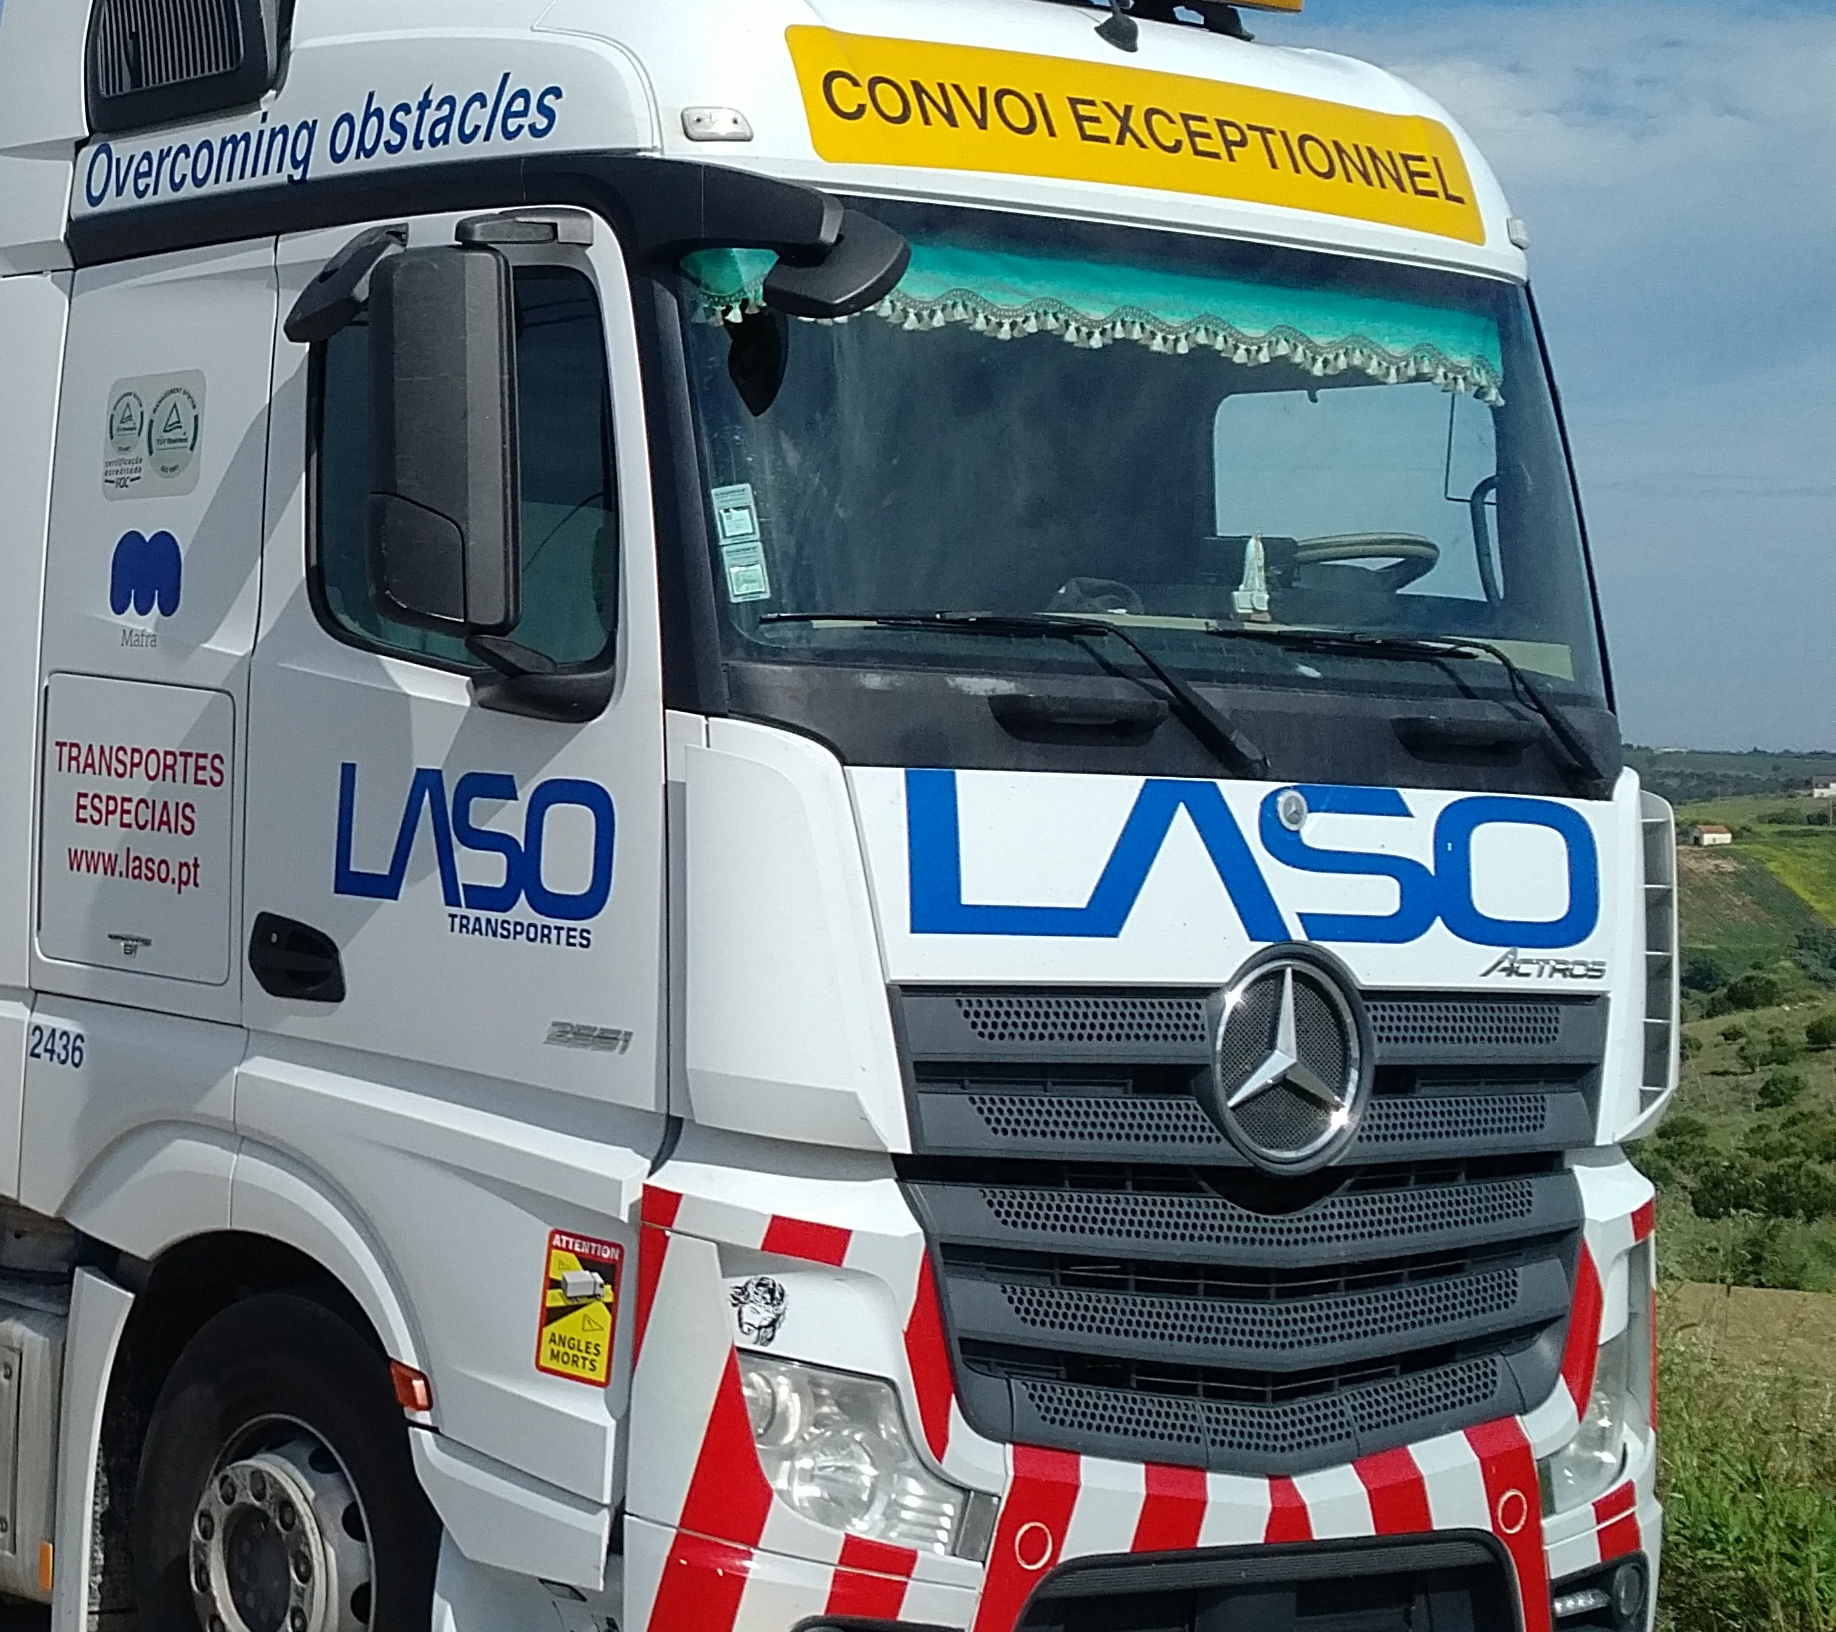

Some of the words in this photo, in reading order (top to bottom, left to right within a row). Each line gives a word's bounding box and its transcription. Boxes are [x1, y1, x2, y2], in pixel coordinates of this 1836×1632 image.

[84, 111, 319, 208] Overcoming
[328, 71, 564, 165] obstacles
[821, 69, 1059, 139] CONVOI
[1064, 96, 1466, 206] EXCEPTIONNEL
[121, 628, 157, 648] Mafra
[55, 740, 225, 788] TRANSPORTES
[75, 791, 196, 836] ESPECIAIS
[333, 762, 616, 921] LASO
[905, 768, 1600, 949] LASO
[67, 846, 201, 895] www.laso.pt
[447, 913, 592, 949] TRANSPORTES
[29, 1024, 85, 1069] 2436
[552, 1234, 620, 1261] ATTENTION
[548, 1331, 602, 1357] ANGLES
[549, 1348, 598, 1373] MORTS
